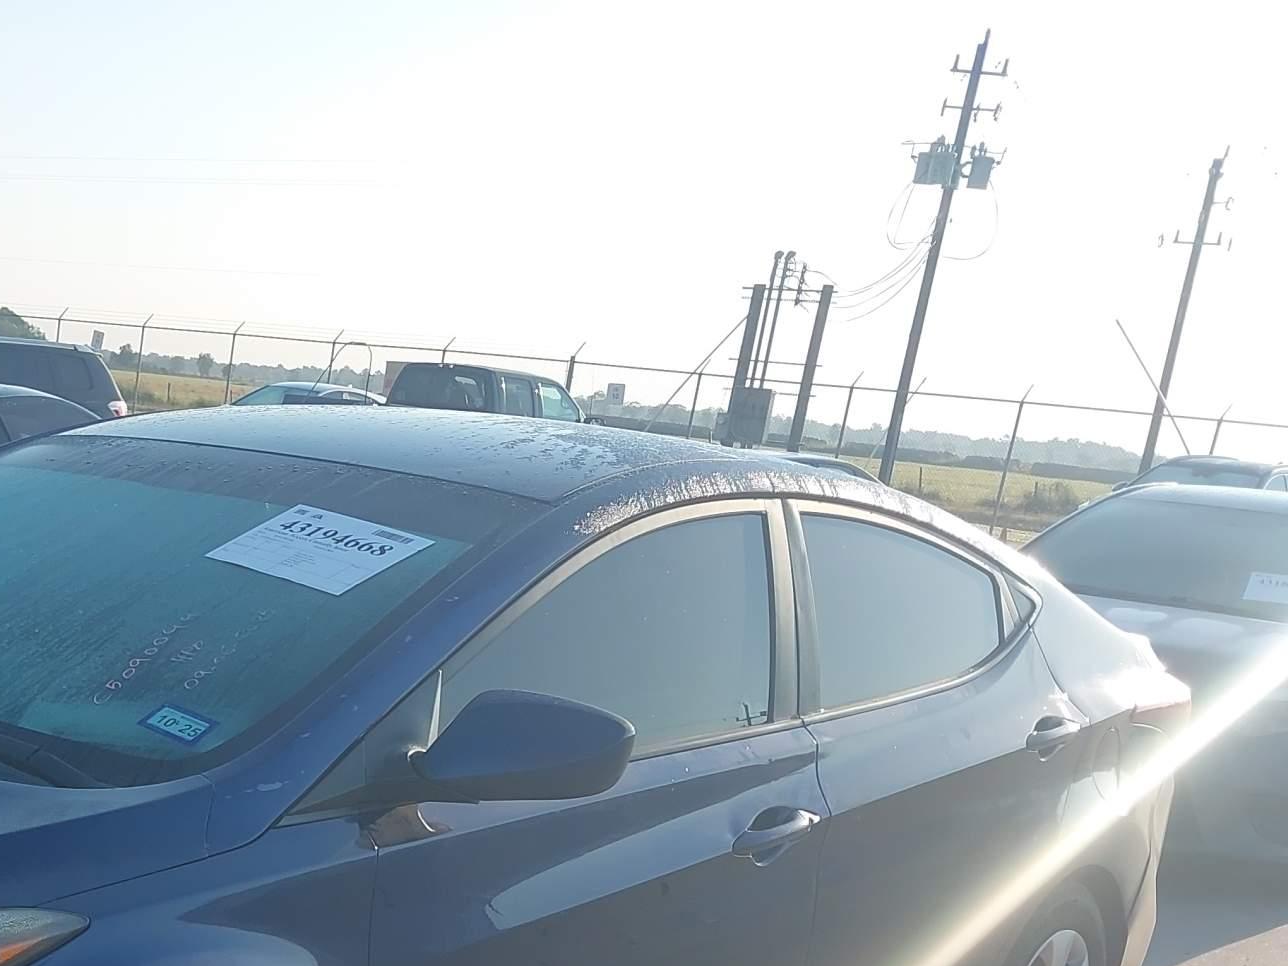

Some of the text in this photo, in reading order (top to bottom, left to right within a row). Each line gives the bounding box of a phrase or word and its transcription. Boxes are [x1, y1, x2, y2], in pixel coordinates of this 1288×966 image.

[279, 519, 395, 557] 43194668
[156, 715, 202, 738] 10 25
